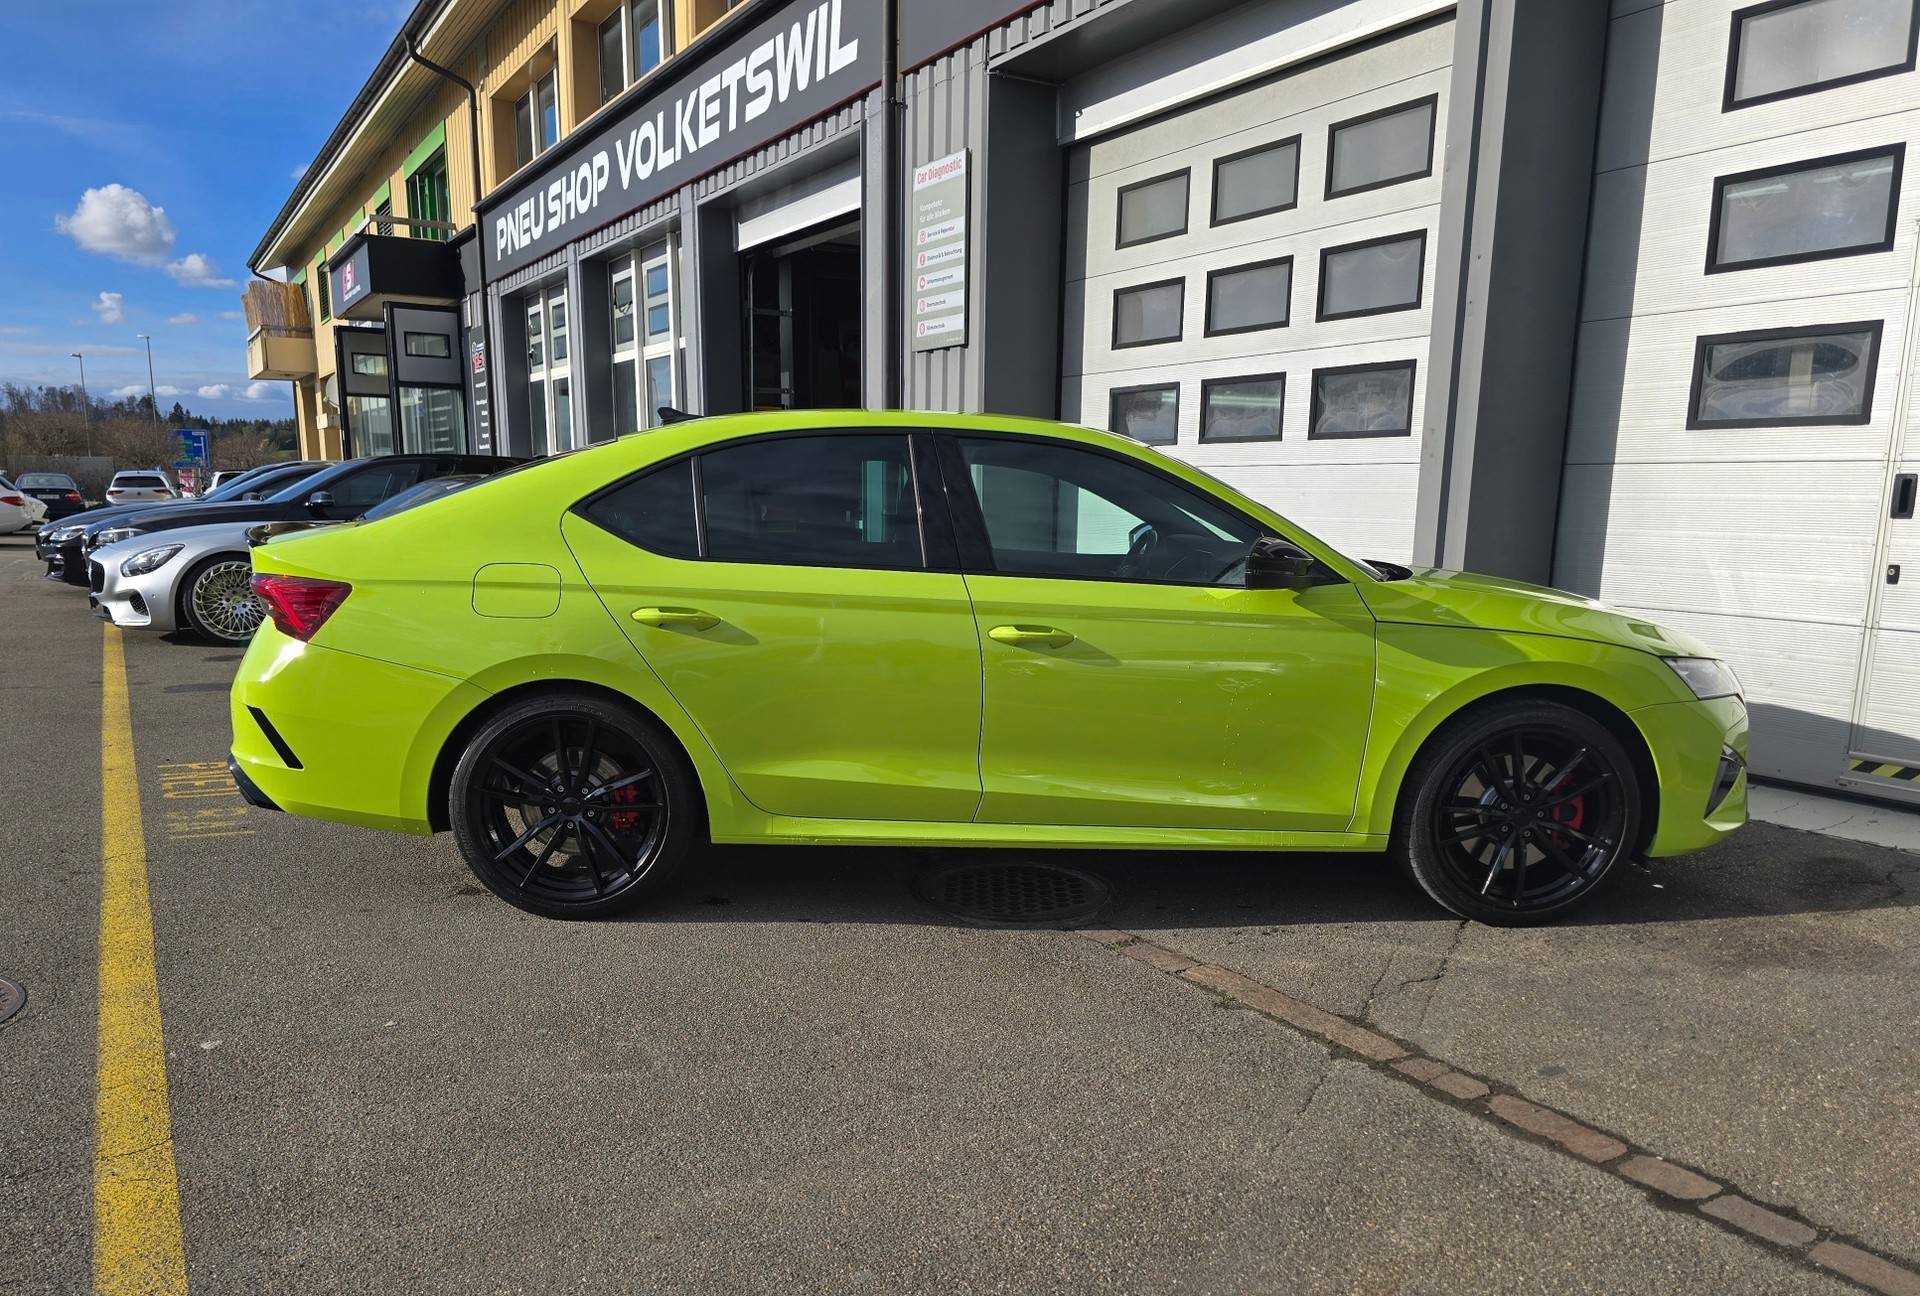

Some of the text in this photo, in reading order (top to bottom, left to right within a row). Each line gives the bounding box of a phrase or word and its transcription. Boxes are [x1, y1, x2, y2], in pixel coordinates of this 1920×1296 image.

[497, 0, 859, 261] PNEU SHOP VOLKETSWIL
[917, 157, 962, 184] Car Diagnostic
